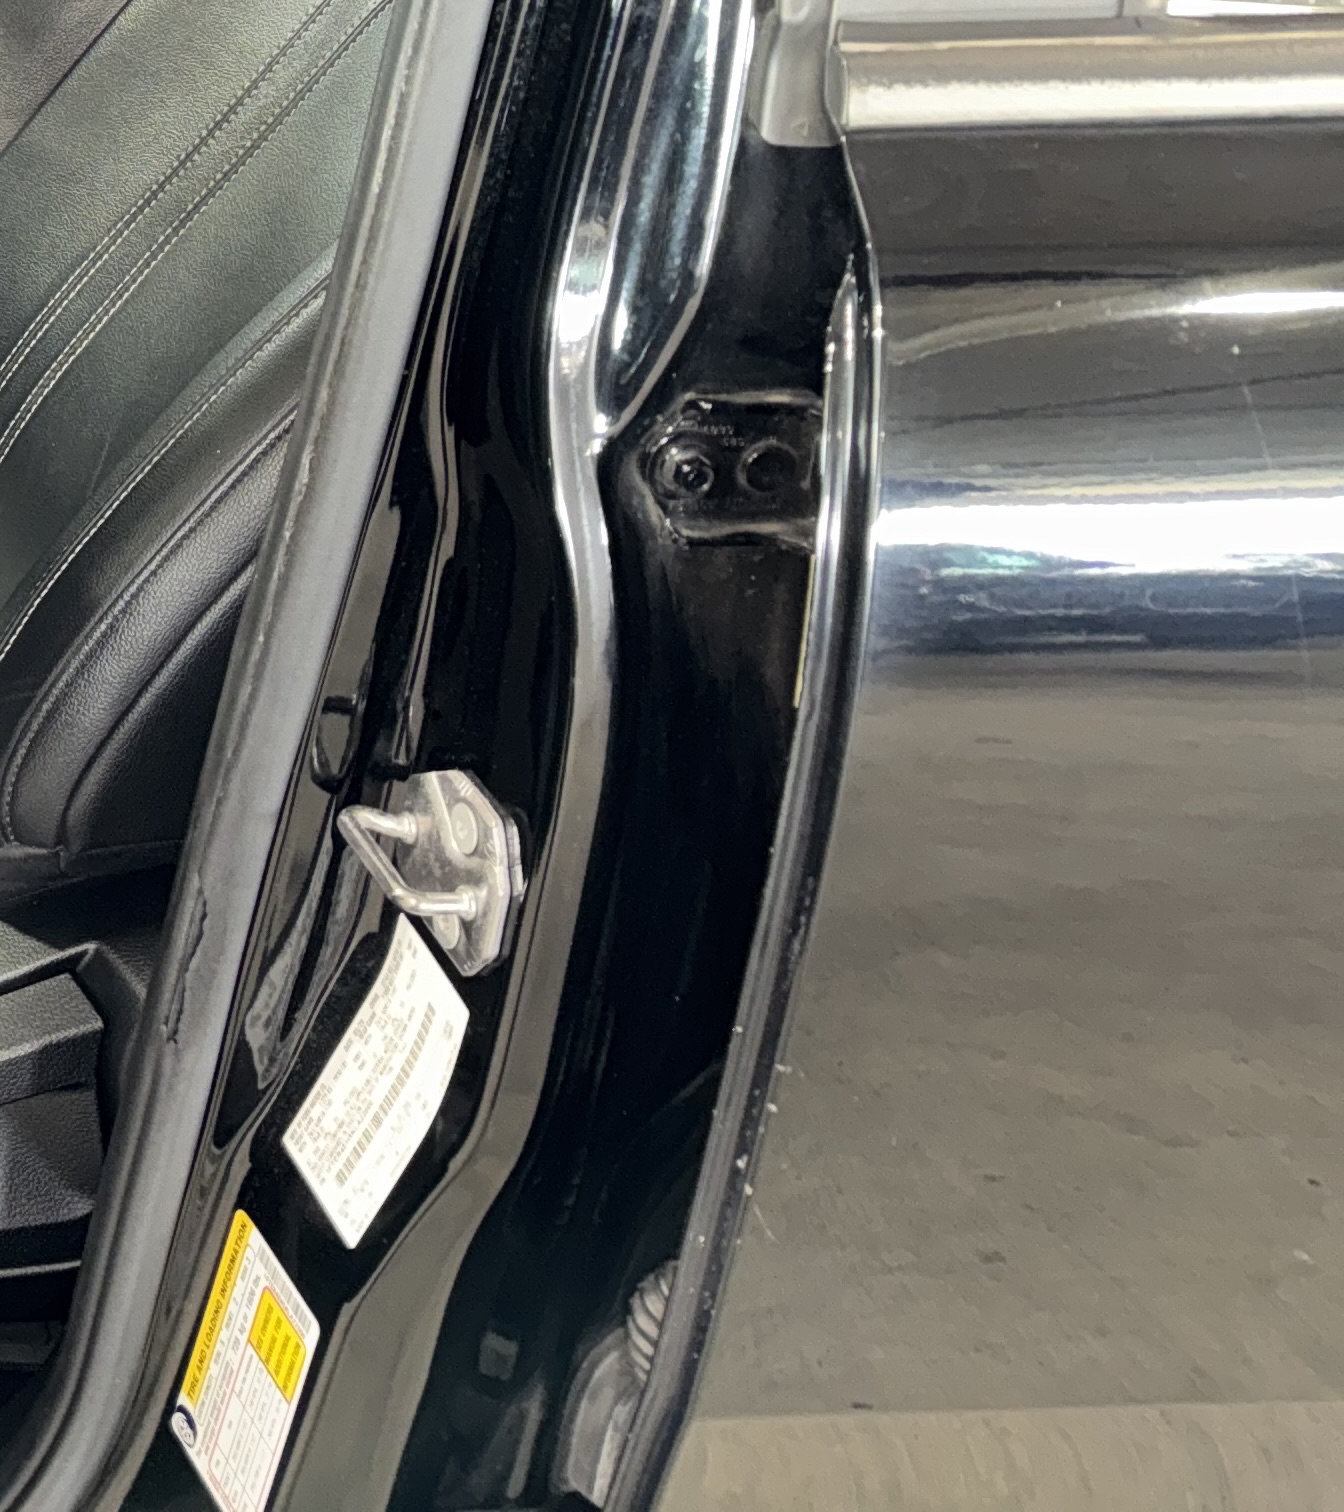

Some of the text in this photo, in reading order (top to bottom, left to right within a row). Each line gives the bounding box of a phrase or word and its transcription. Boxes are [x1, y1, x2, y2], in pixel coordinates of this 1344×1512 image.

[187, 1375, 199, 1401] TIRE
[195, 1351, 207, 1373] AND
[203, 1301, 222, 1349] LOADING
[220, 1220, 247, 1298] INFORMATION
